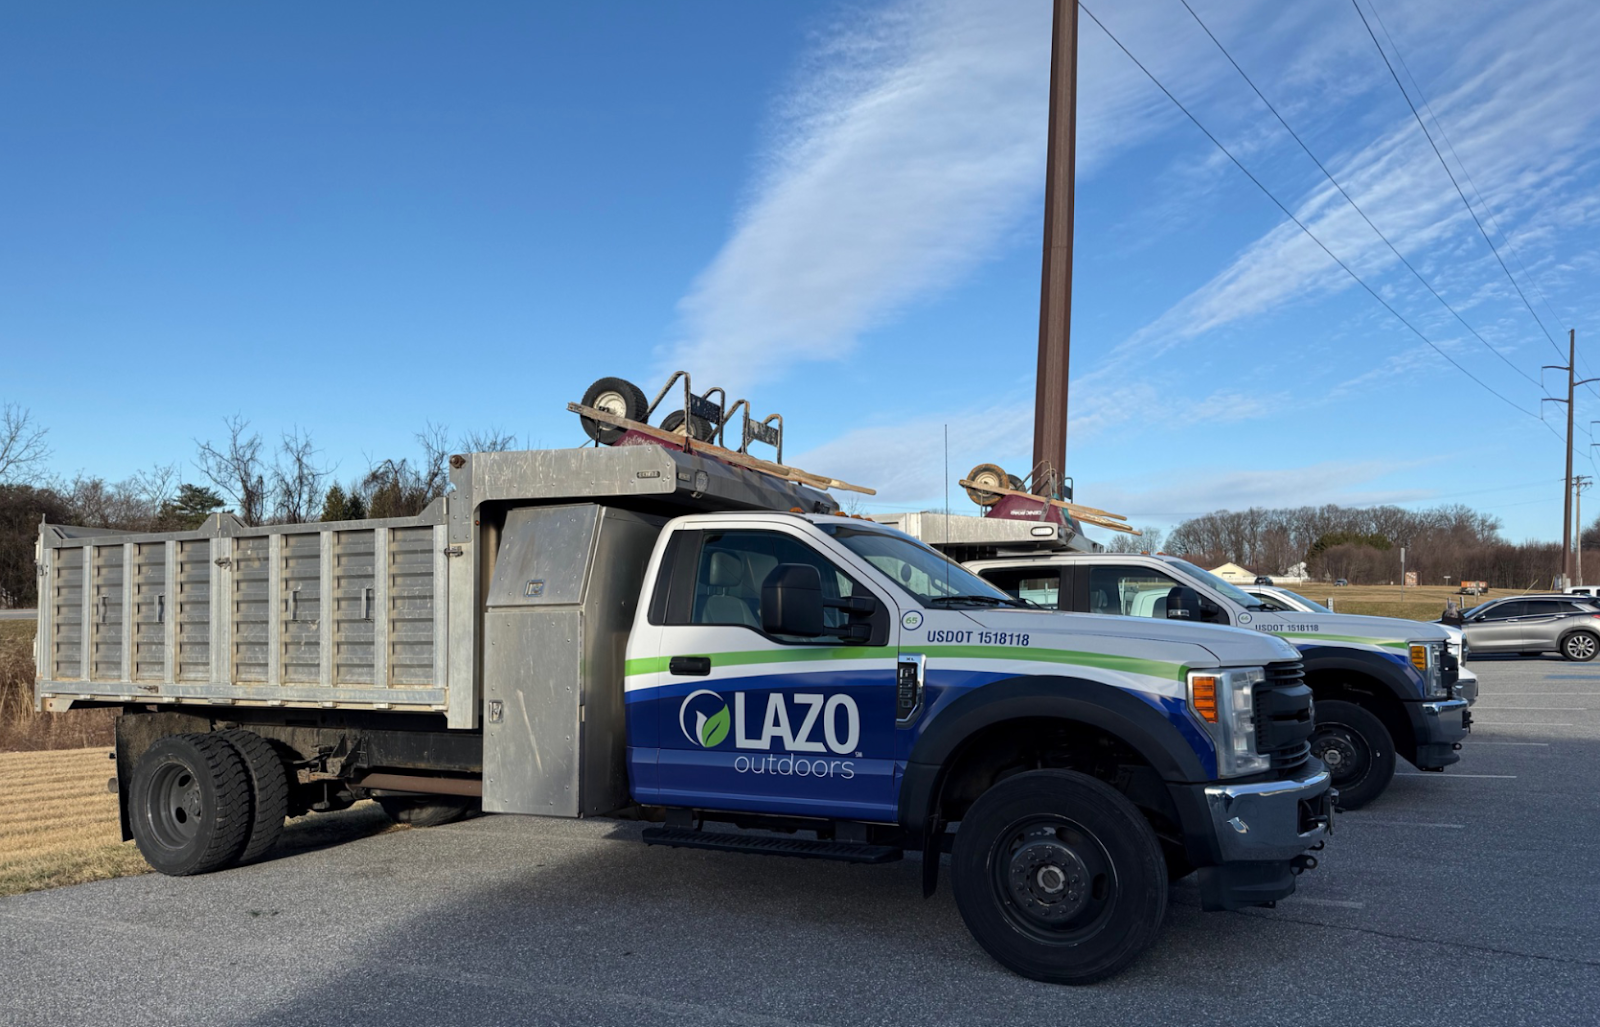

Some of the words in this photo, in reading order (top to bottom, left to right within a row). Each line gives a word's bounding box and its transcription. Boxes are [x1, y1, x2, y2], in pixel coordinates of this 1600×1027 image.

[905, 616, 918, 625] 65
[1255, 624, 1284, 632] USDOT
[1287, 624, 1319, 632] 1518118
[927, 630, 973, 643] USDOT
[977, 631, 1030, 646] 1518118
[735, 691, 860, 755] LAZO
[734, 753, 855, 779] outdoors
